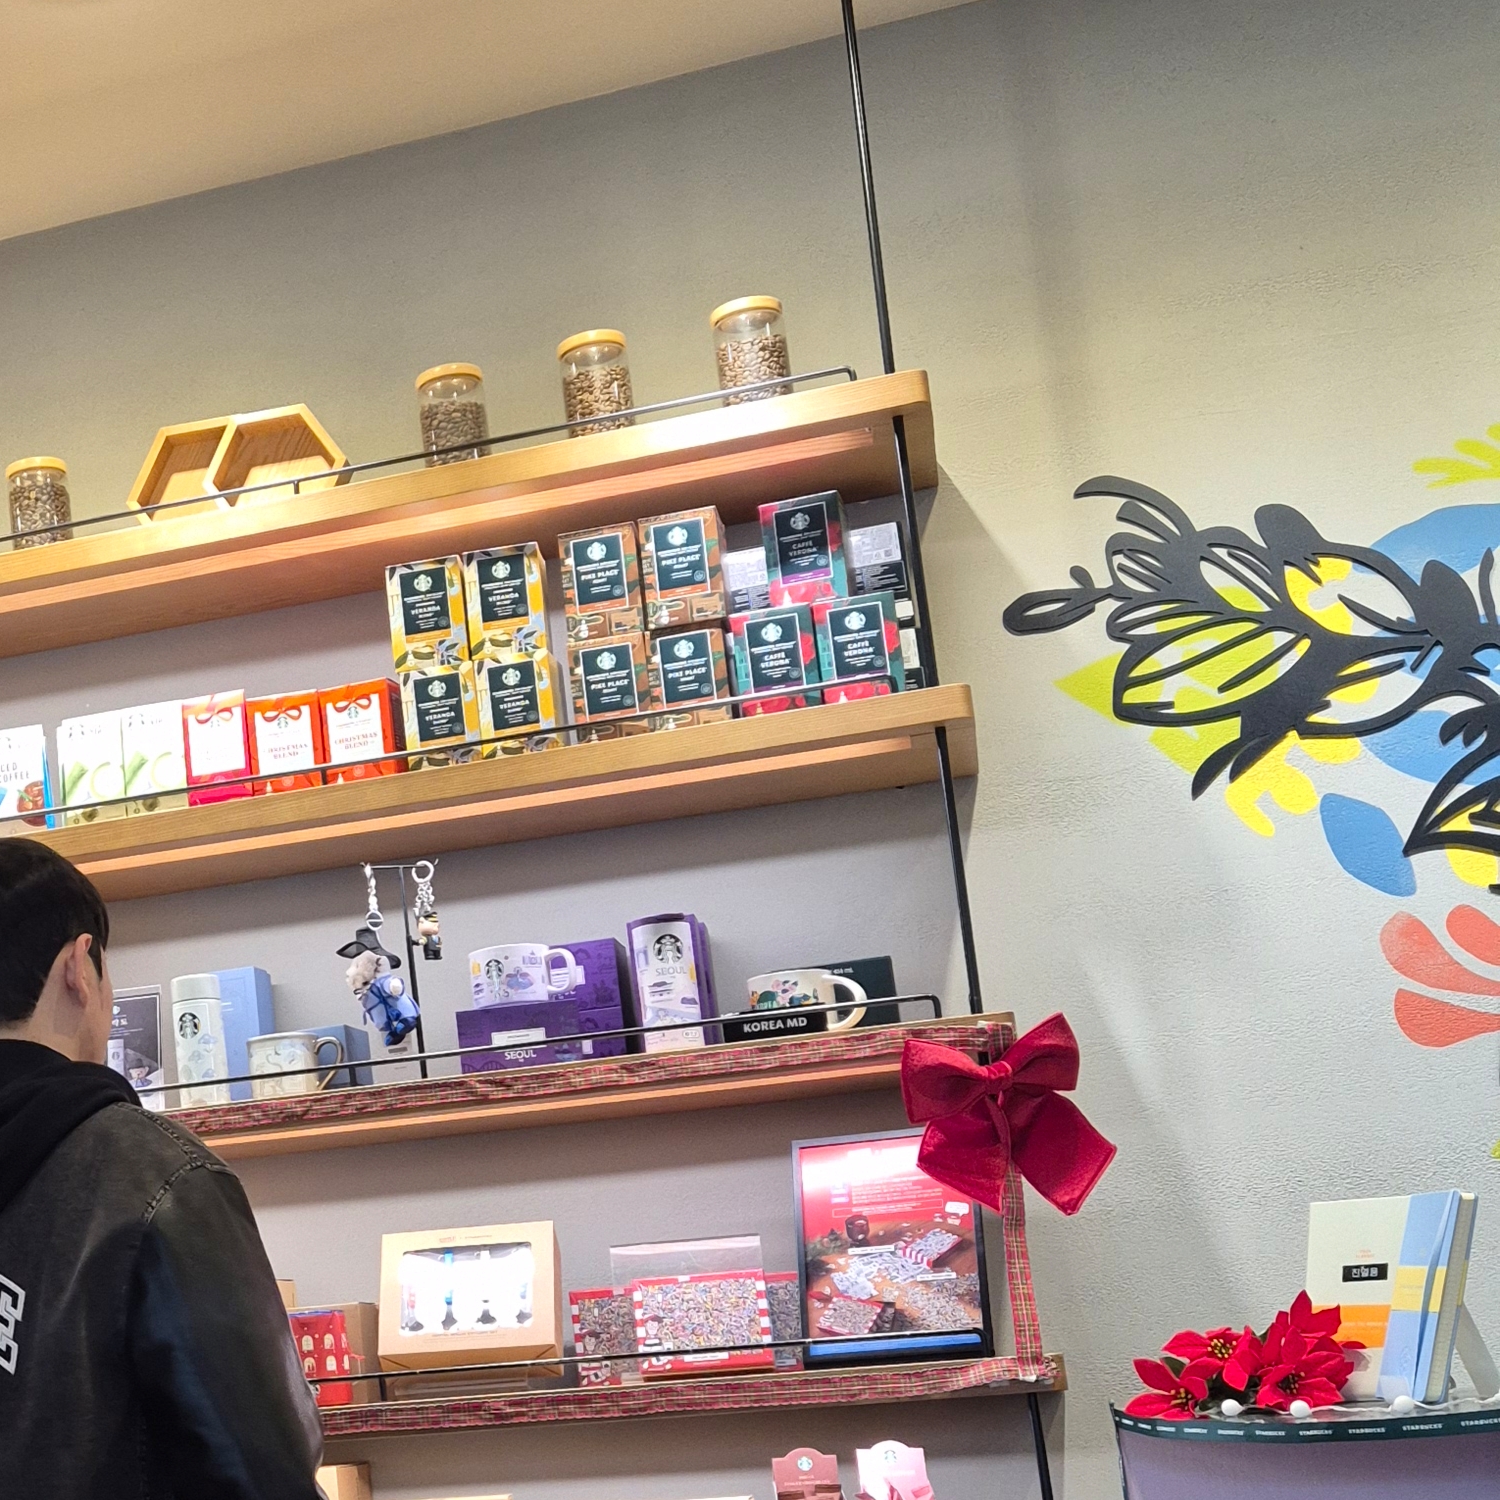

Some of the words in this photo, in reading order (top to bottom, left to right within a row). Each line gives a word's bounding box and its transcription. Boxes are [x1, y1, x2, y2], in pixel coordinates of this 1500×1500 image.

[655, 966, 688, 977] SEOUL
[743, 1021, 785, 1033] KOREA
[786, 1017, 808, 1028] MD
[504, 1049, 537, 1060] SEOUL
[1402, 1423, 1443, 1431] STARBUCKS
